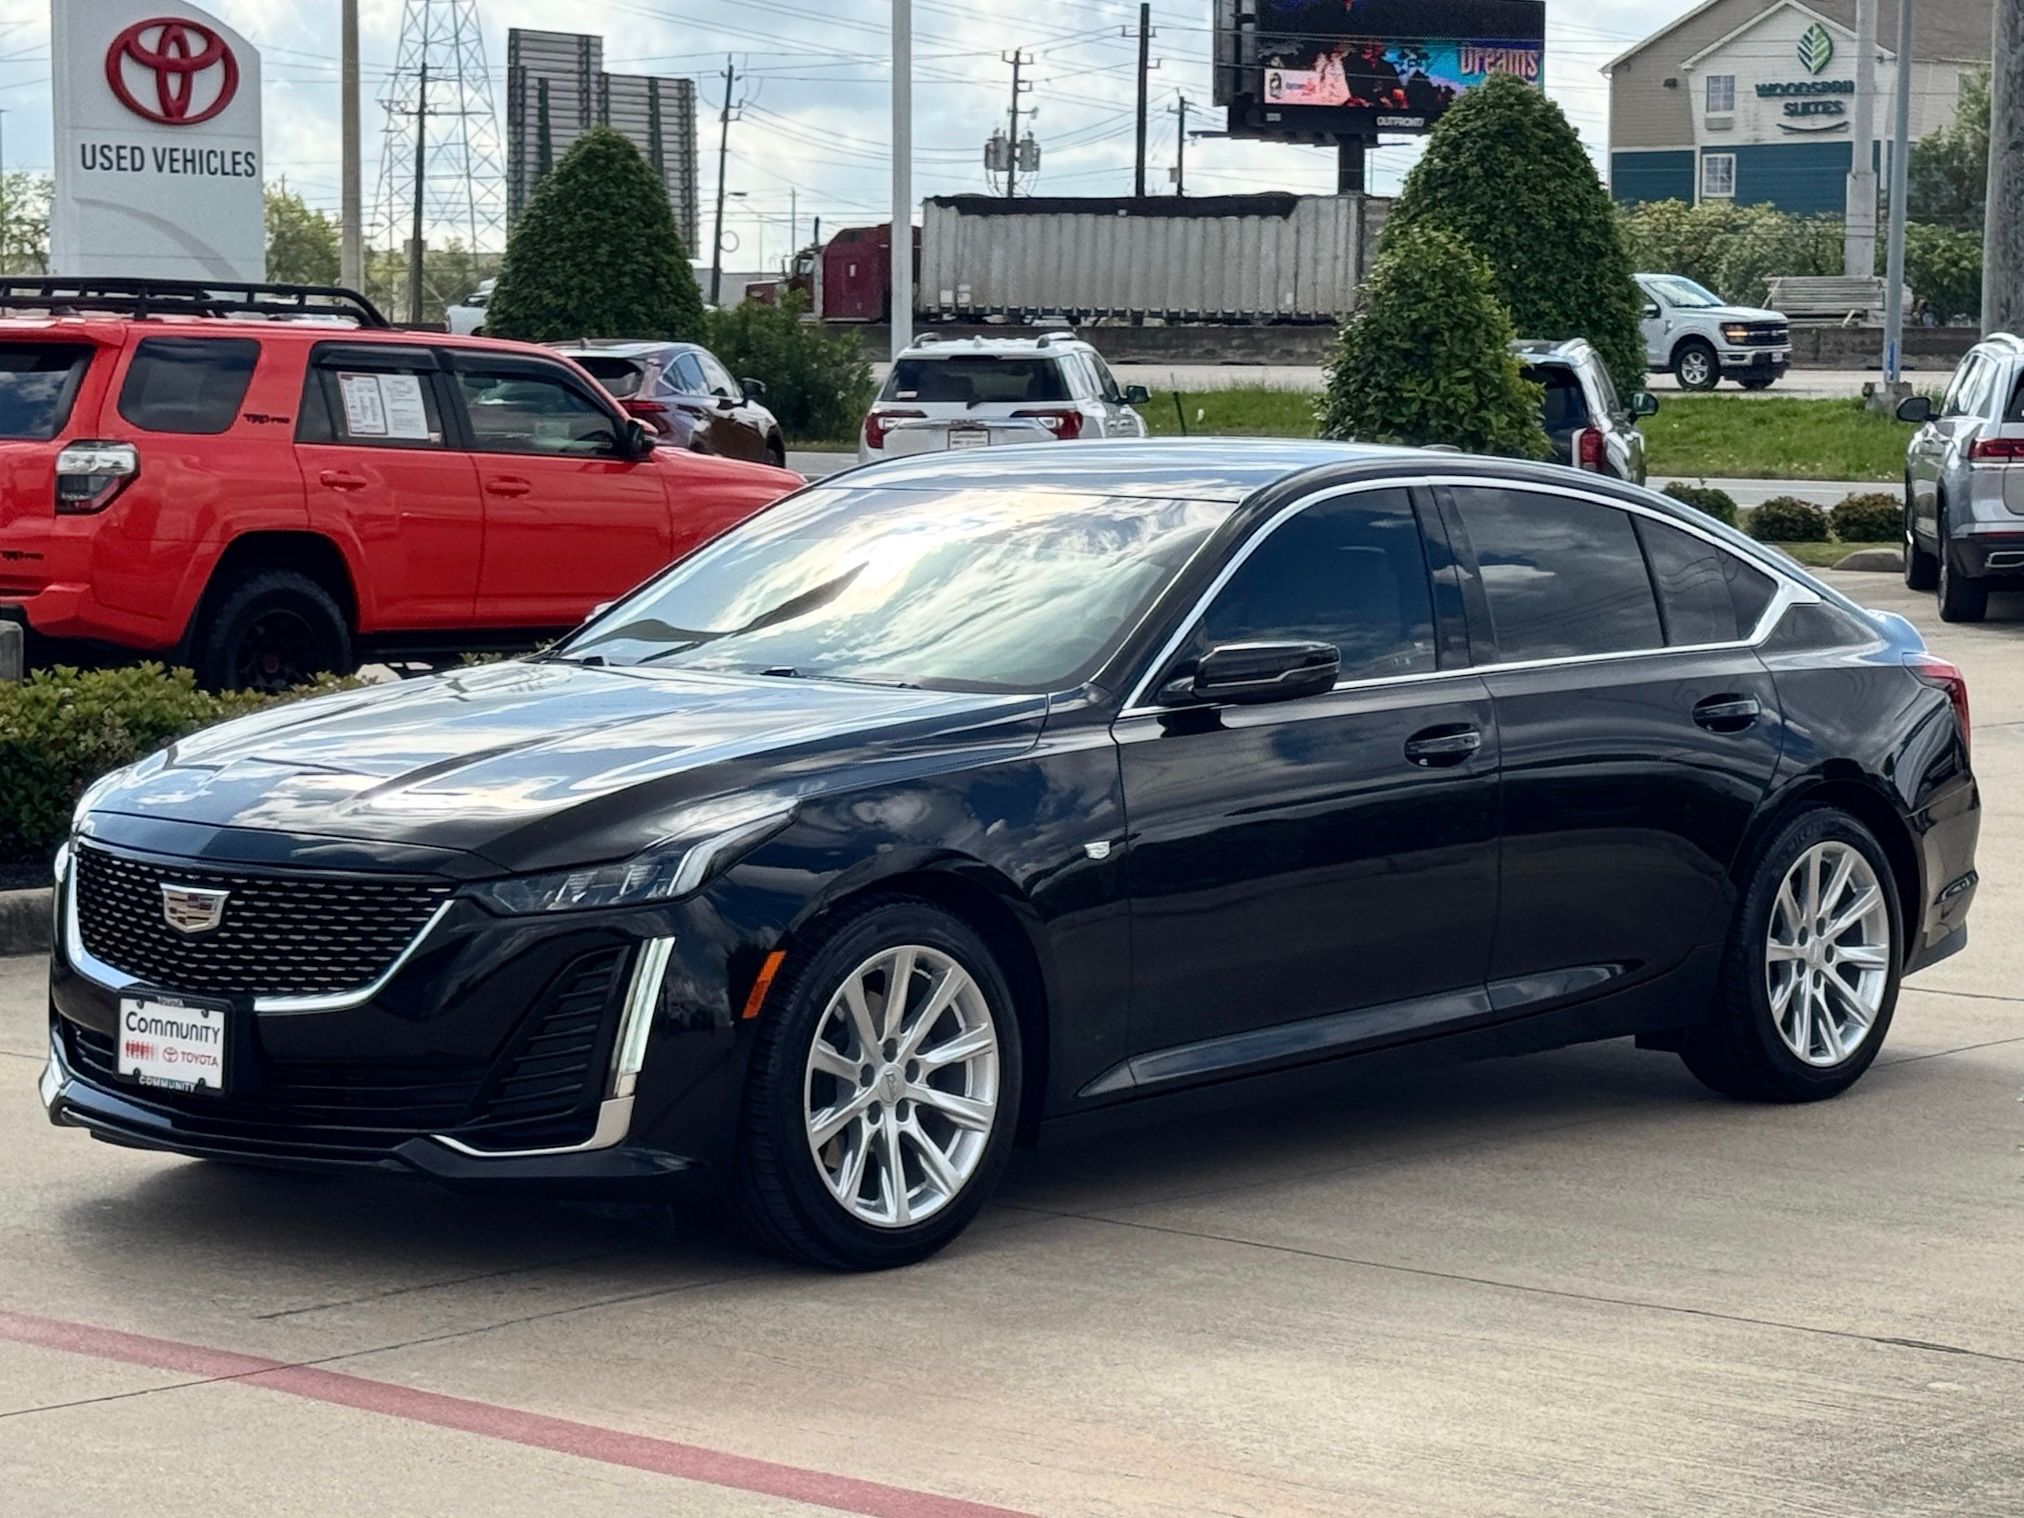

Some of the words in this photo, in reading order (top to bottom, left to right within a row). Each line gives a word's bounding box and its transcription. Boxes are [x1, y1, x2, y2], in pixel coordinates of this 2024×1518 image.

[81, 143, 145, 172] USED
[152, 146, 256, 178] VEHICLES
[181, 1050, 219, 1068] TOYOTA
[139, 1075, 196, 1093] COMMUNITY
